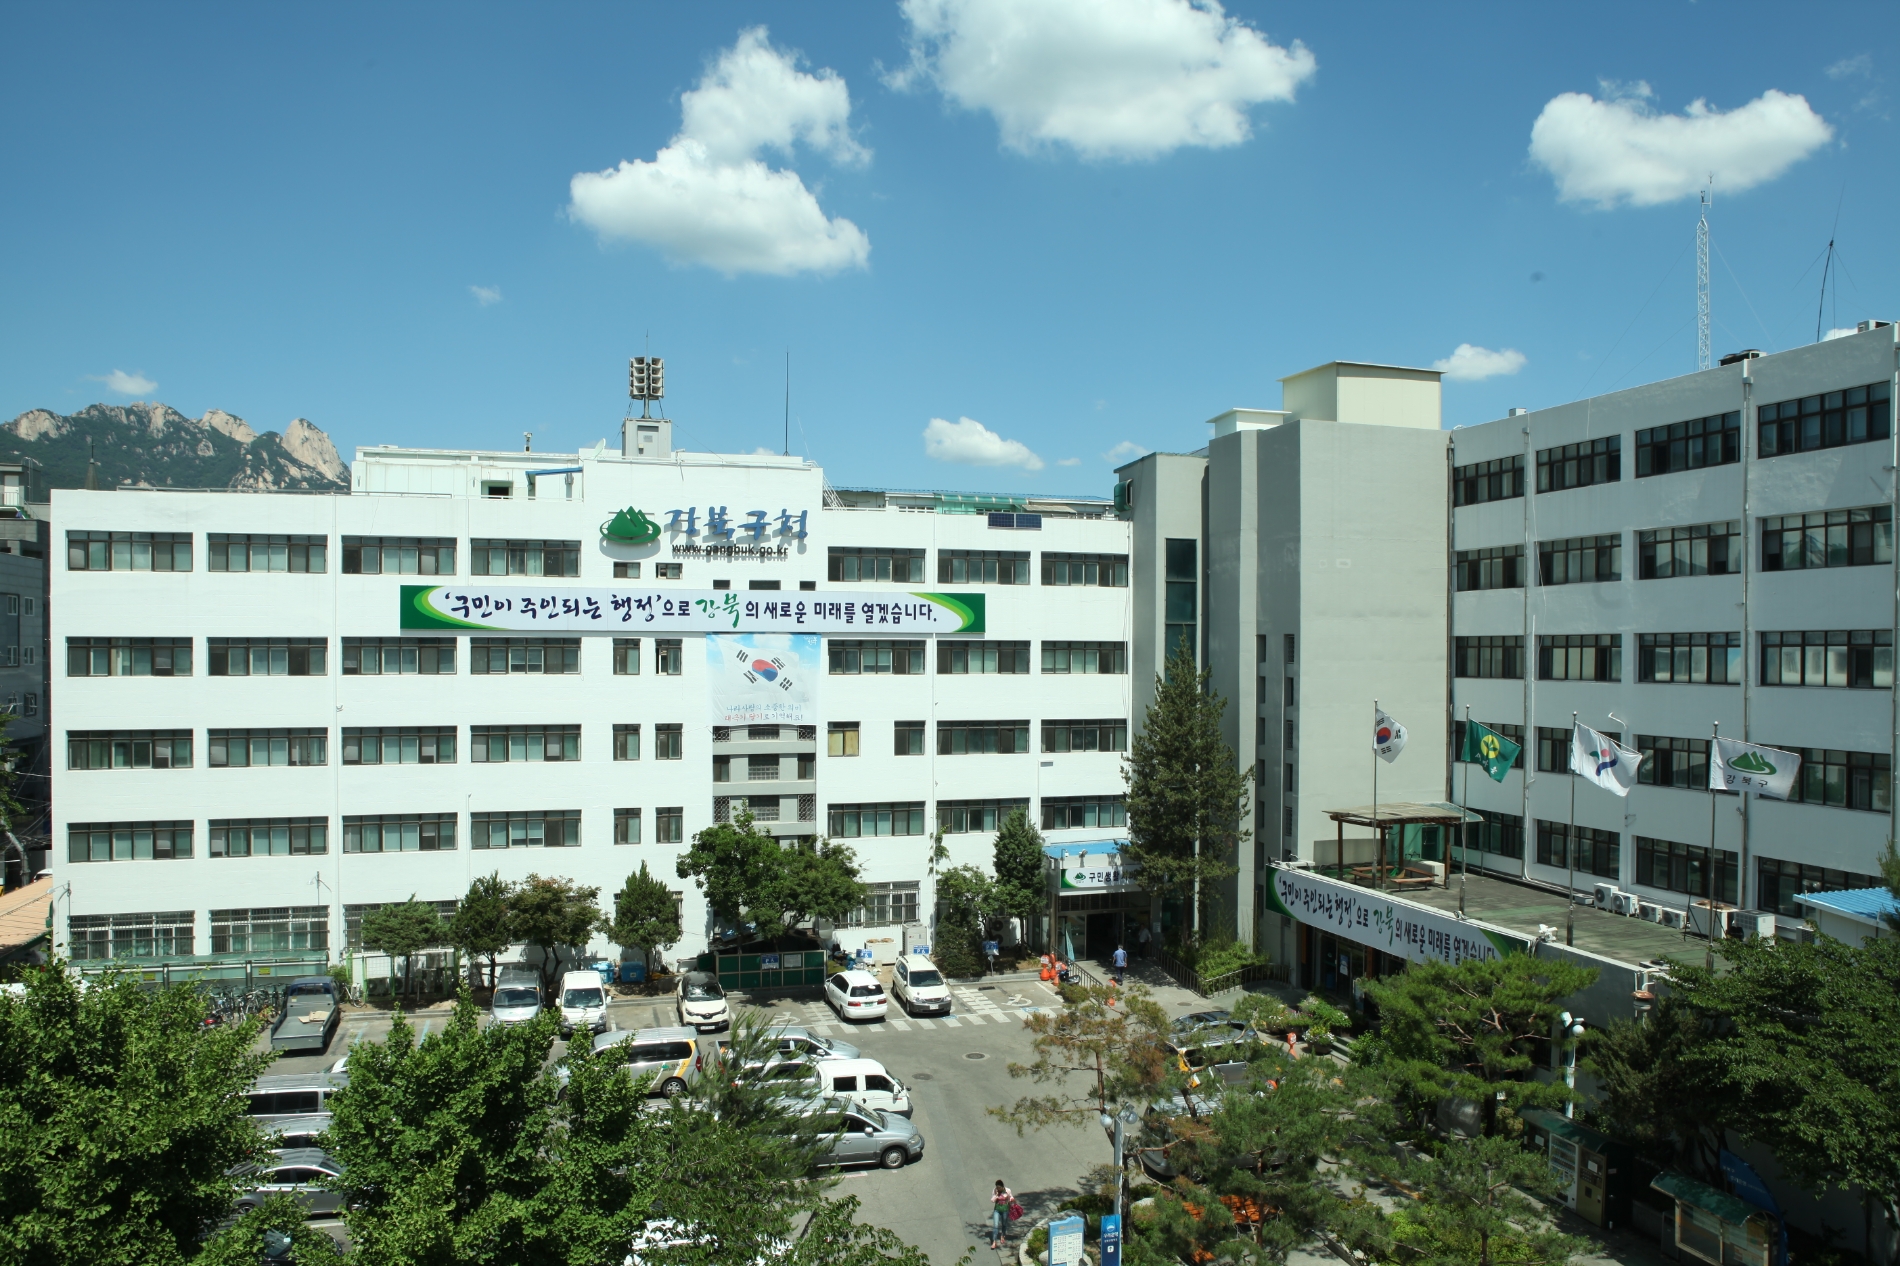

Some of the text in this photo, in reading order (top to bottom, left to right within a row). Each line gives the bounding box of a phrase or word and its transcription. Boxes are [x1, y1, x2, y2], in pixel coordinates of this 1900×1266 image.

[664, 505, 808, 541] 강북구청
[671, 543, 789, 557] www.gangbuk.go.kr
[520, 595, 602, 620] 주인되는
[763, 601, 807, 624] 새로운
[814, 602, 856, 624] 미래를
[861, 602, 938, 625] 열겠습니다.
[1726, 774, 1769, 788] 강북구
[1303, 888, 1333, 919] 주인되는
[1404, 921, 1425, 954] 새로운
